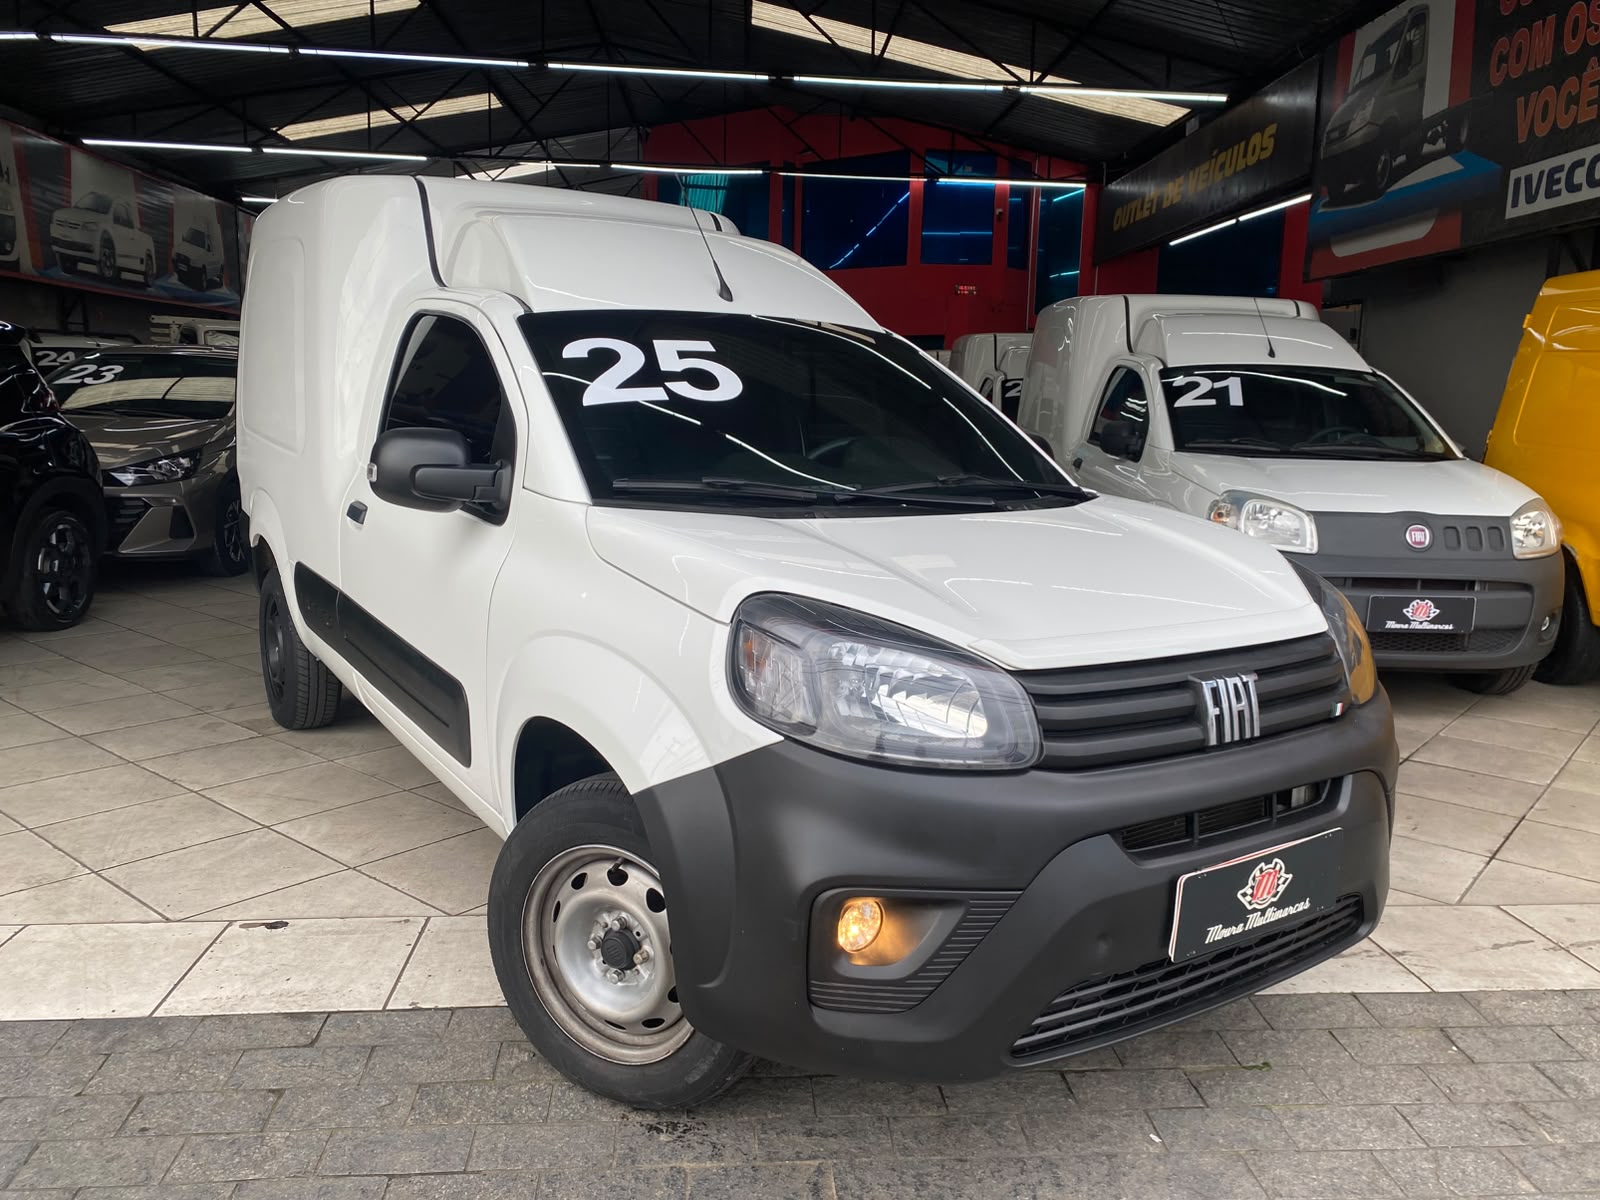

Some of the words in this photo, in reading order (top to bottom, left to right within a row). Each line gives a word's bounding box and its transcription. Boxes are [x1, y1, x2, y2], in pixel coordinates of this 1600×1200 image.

[1489, 14, 1556, 87] COM
[1516, 56, 1600, 145] VOCÊ
[1112, 186, 1160, 232] OUTLET
[1162, 175, 1184, 209] DE
[35, 350, 76, 366] 24
[52, 364, 125, 385] 23
[562, 337, 743, 407] 25
[1172, 376, 1244, 407] 21
[1201, 672, 1261, 746] FIAT
[1205, 923, 1246, 944] Moura
[1245, 898, 1311, 931] Multimarcas
